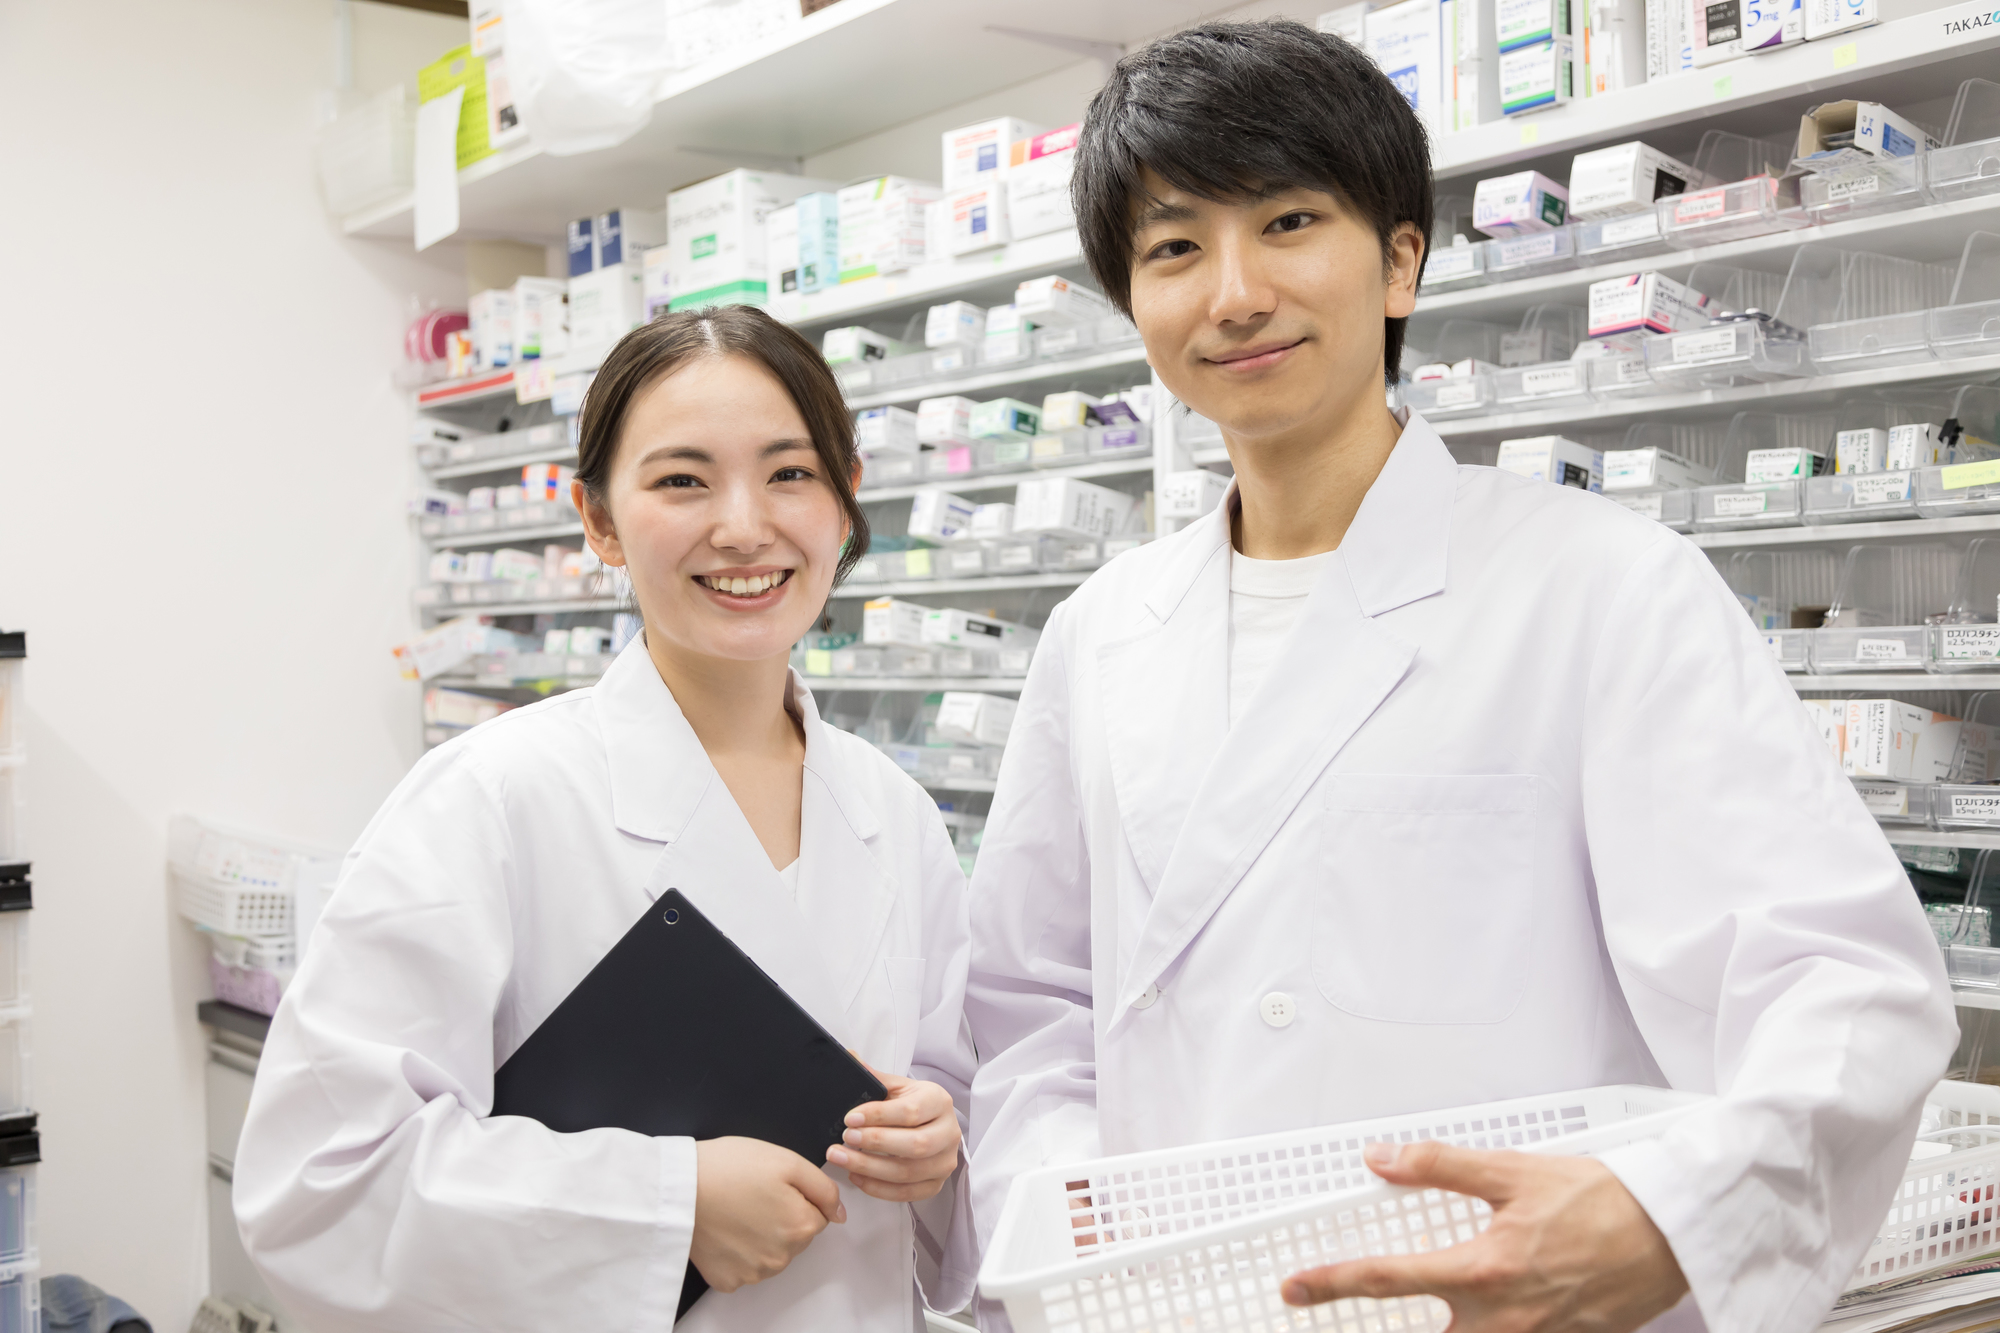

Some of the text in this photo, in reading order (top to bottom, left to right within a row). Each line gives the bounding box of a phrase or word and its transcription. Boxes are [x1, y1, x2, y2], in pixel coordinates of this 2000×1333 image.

[1746, 0, 1762, 27] 5
[1763, 11, 1779, 21] mg
[1849, 703, 1861, 723] 60
